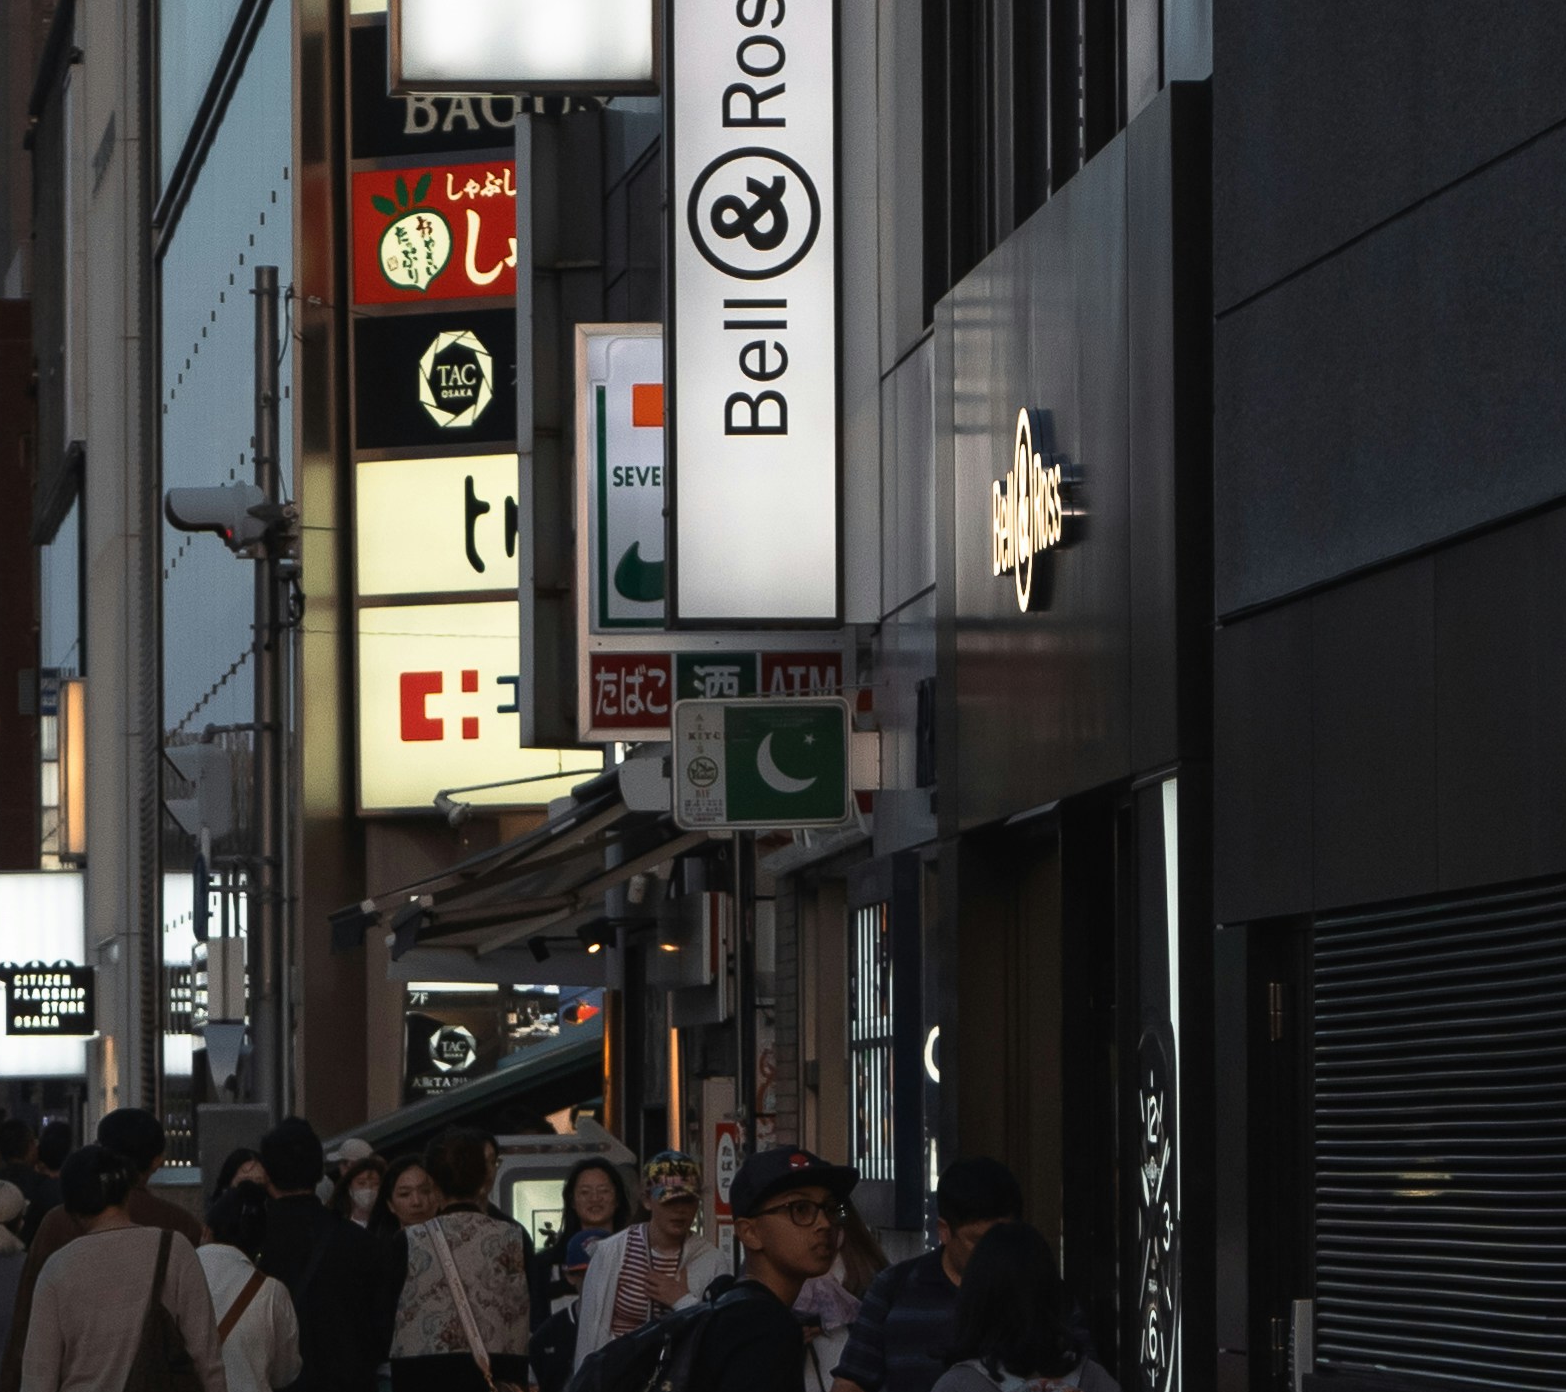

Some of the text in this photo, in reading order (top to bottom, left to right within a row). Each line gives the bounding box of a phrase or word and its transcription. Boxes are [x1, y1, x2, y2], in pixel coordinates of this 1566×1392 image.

[710, 174, 790, 252] &
[436, 364, 476, 386] TAC
[723, 297, 789, 436] Bell
[440, 388, 473, 399] OSAKA
[613, 465, 665, 487] SEVE
[992, 470, 1014, 576] Bell
[1033, 452, 1061, 554] Ross
[595, 663, 668, 716] たばこ
[769, 666, 837, 697] ATM
[13, 973, 72, 987] CITIZEN
[13, 987, 86, 1001] FLAGSHIP
[41, 1000, 86, 1014] STORE
[13, 1014, 60, 1028] OSAKA
[721, 1145, 733, 1189] たばこ
